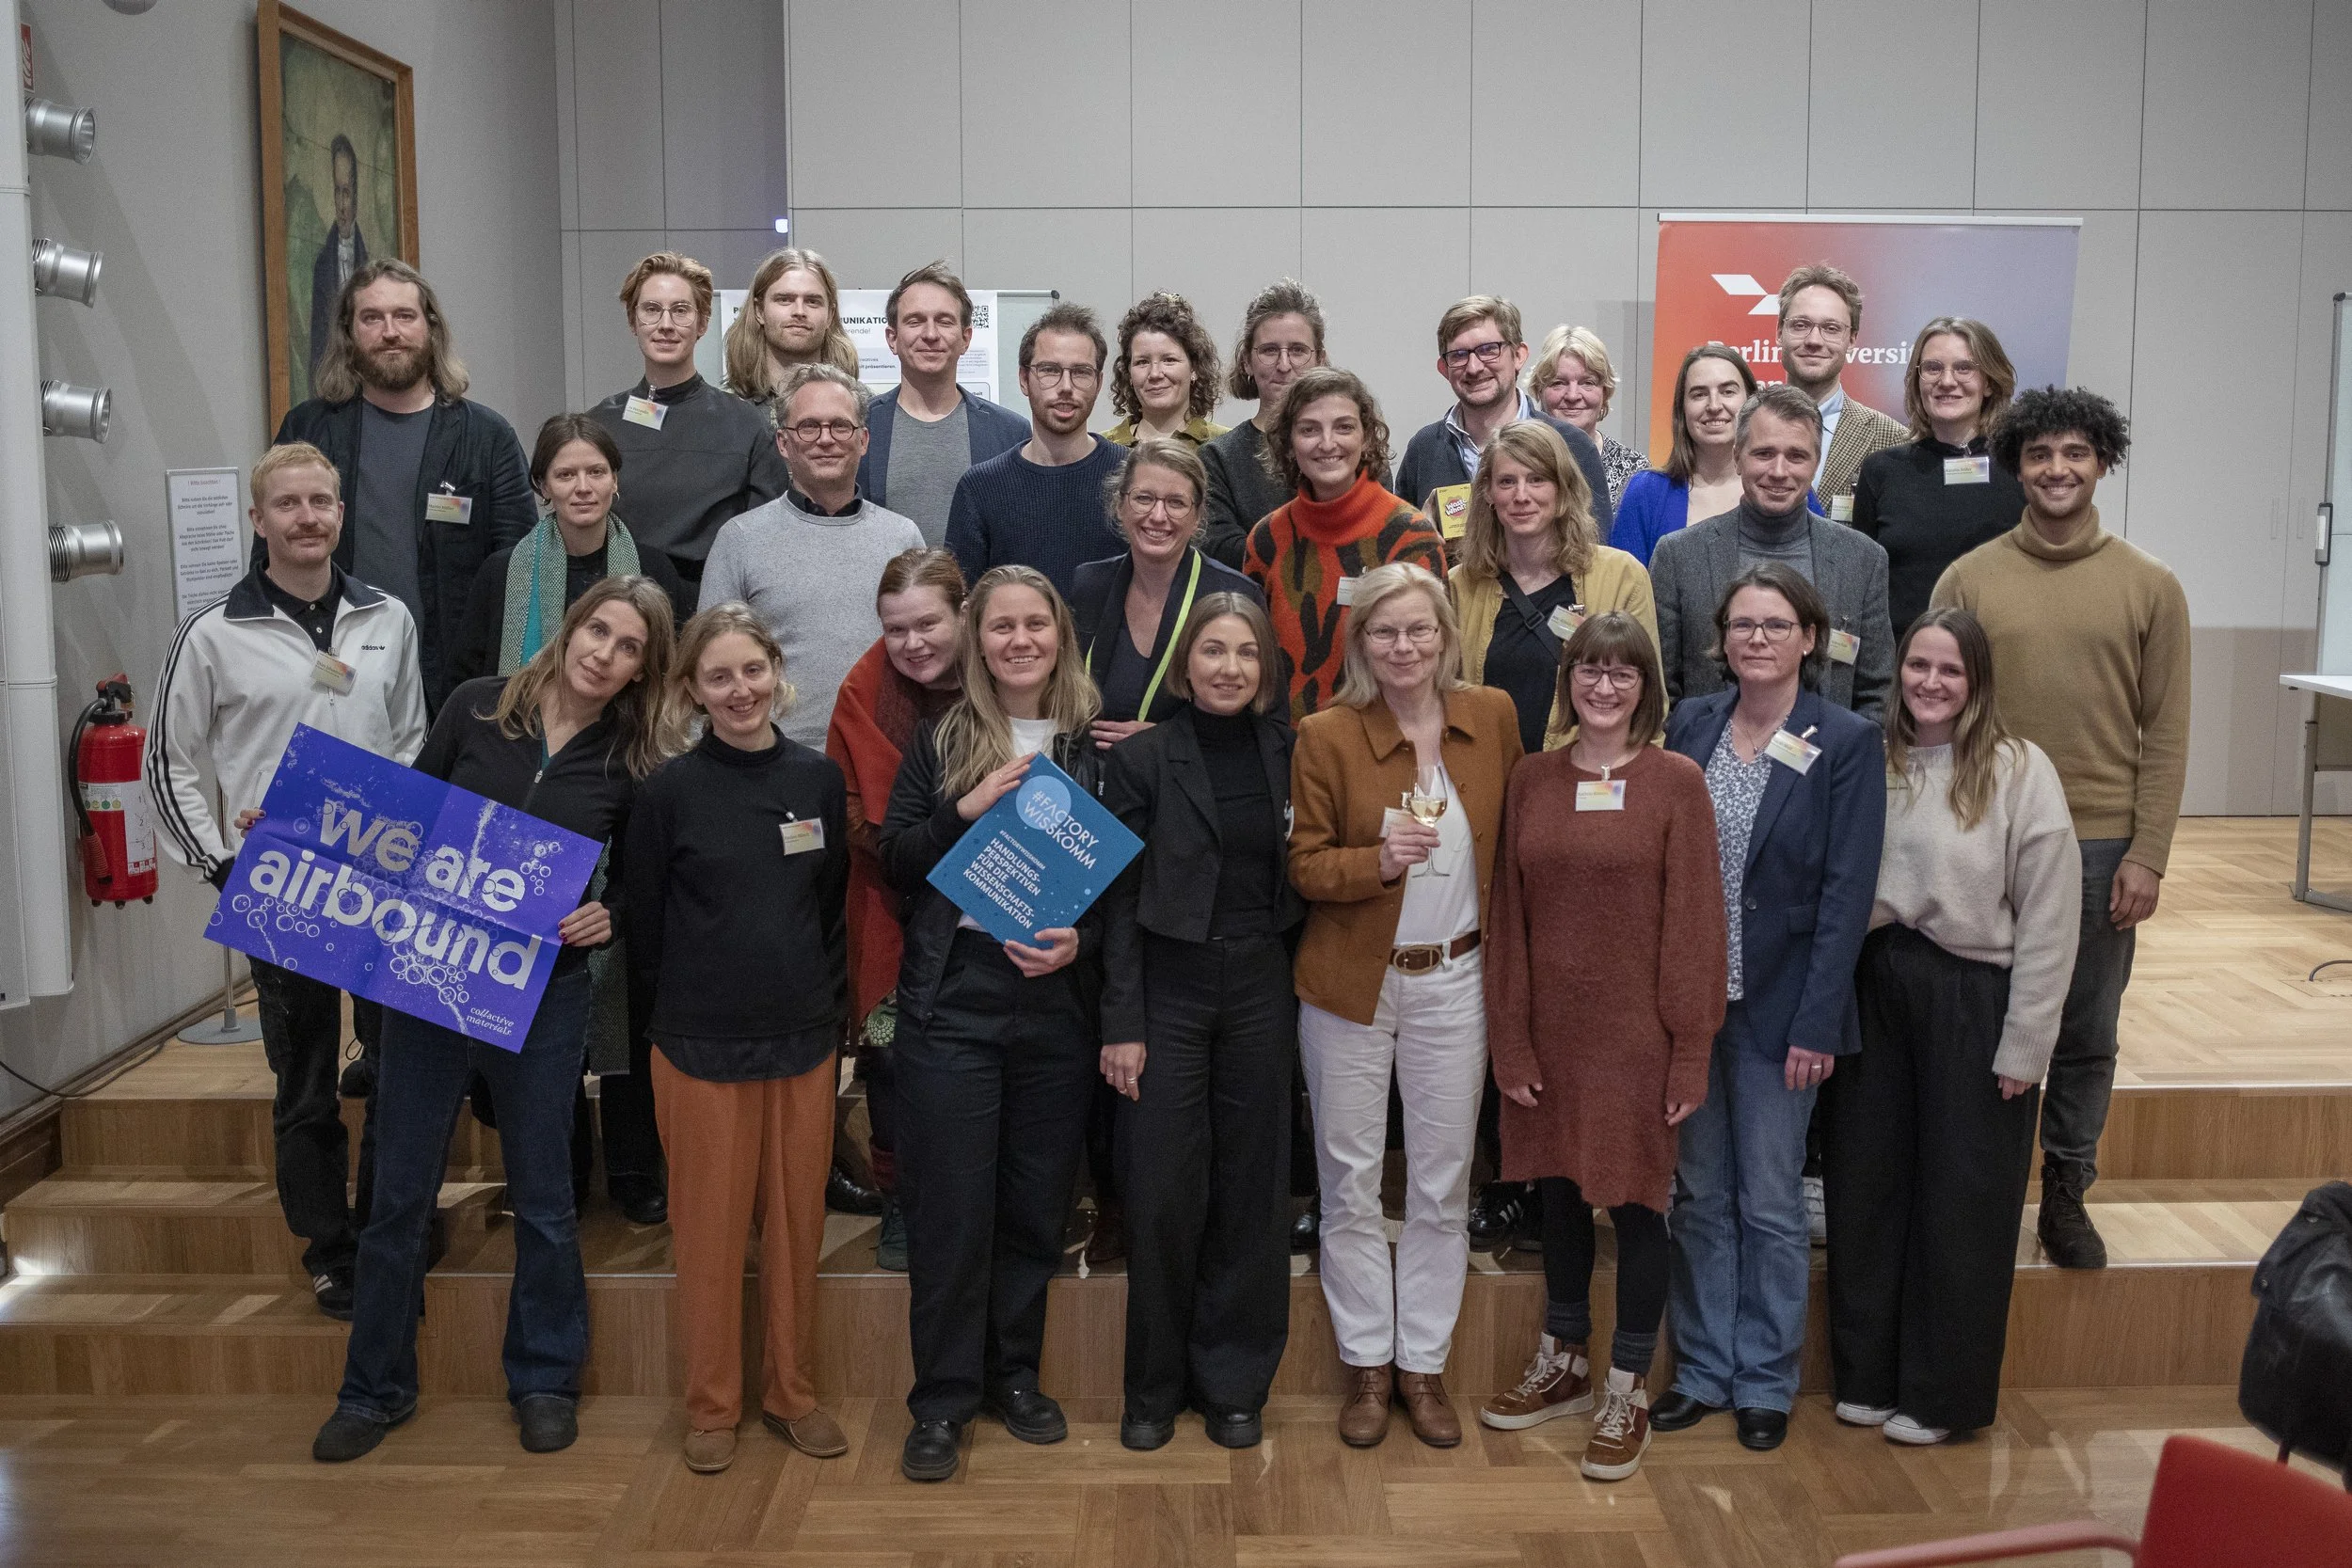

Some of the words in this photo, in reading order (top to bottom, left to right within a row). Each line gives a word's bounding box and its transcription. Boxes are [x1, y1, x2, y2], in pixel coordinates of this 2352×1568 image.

[1708, 340, 1783, 363] rlin
[1024, 801, 1097, 870] WISSKOMM
[1032, 790, 1099, 849] #FACTORY
[319, 797, 419, 872] we
[424, 844, 526, 912] are
[977, 852, 996, 871] FÜR
[992, 866, 1008, 883] DIE
[984, 845, 1041, 896] PERSPEKTIVEN
[990, 838, 1041, 883] HANDLUNGS-
[963, 869, 1033, 929] KOMMUNIKATION
[970, 860, 1035, 918] WISSENSCHAFTS-
[249, 849, 543, 990] airbound
[466, 1015, 512, 1036] materials
